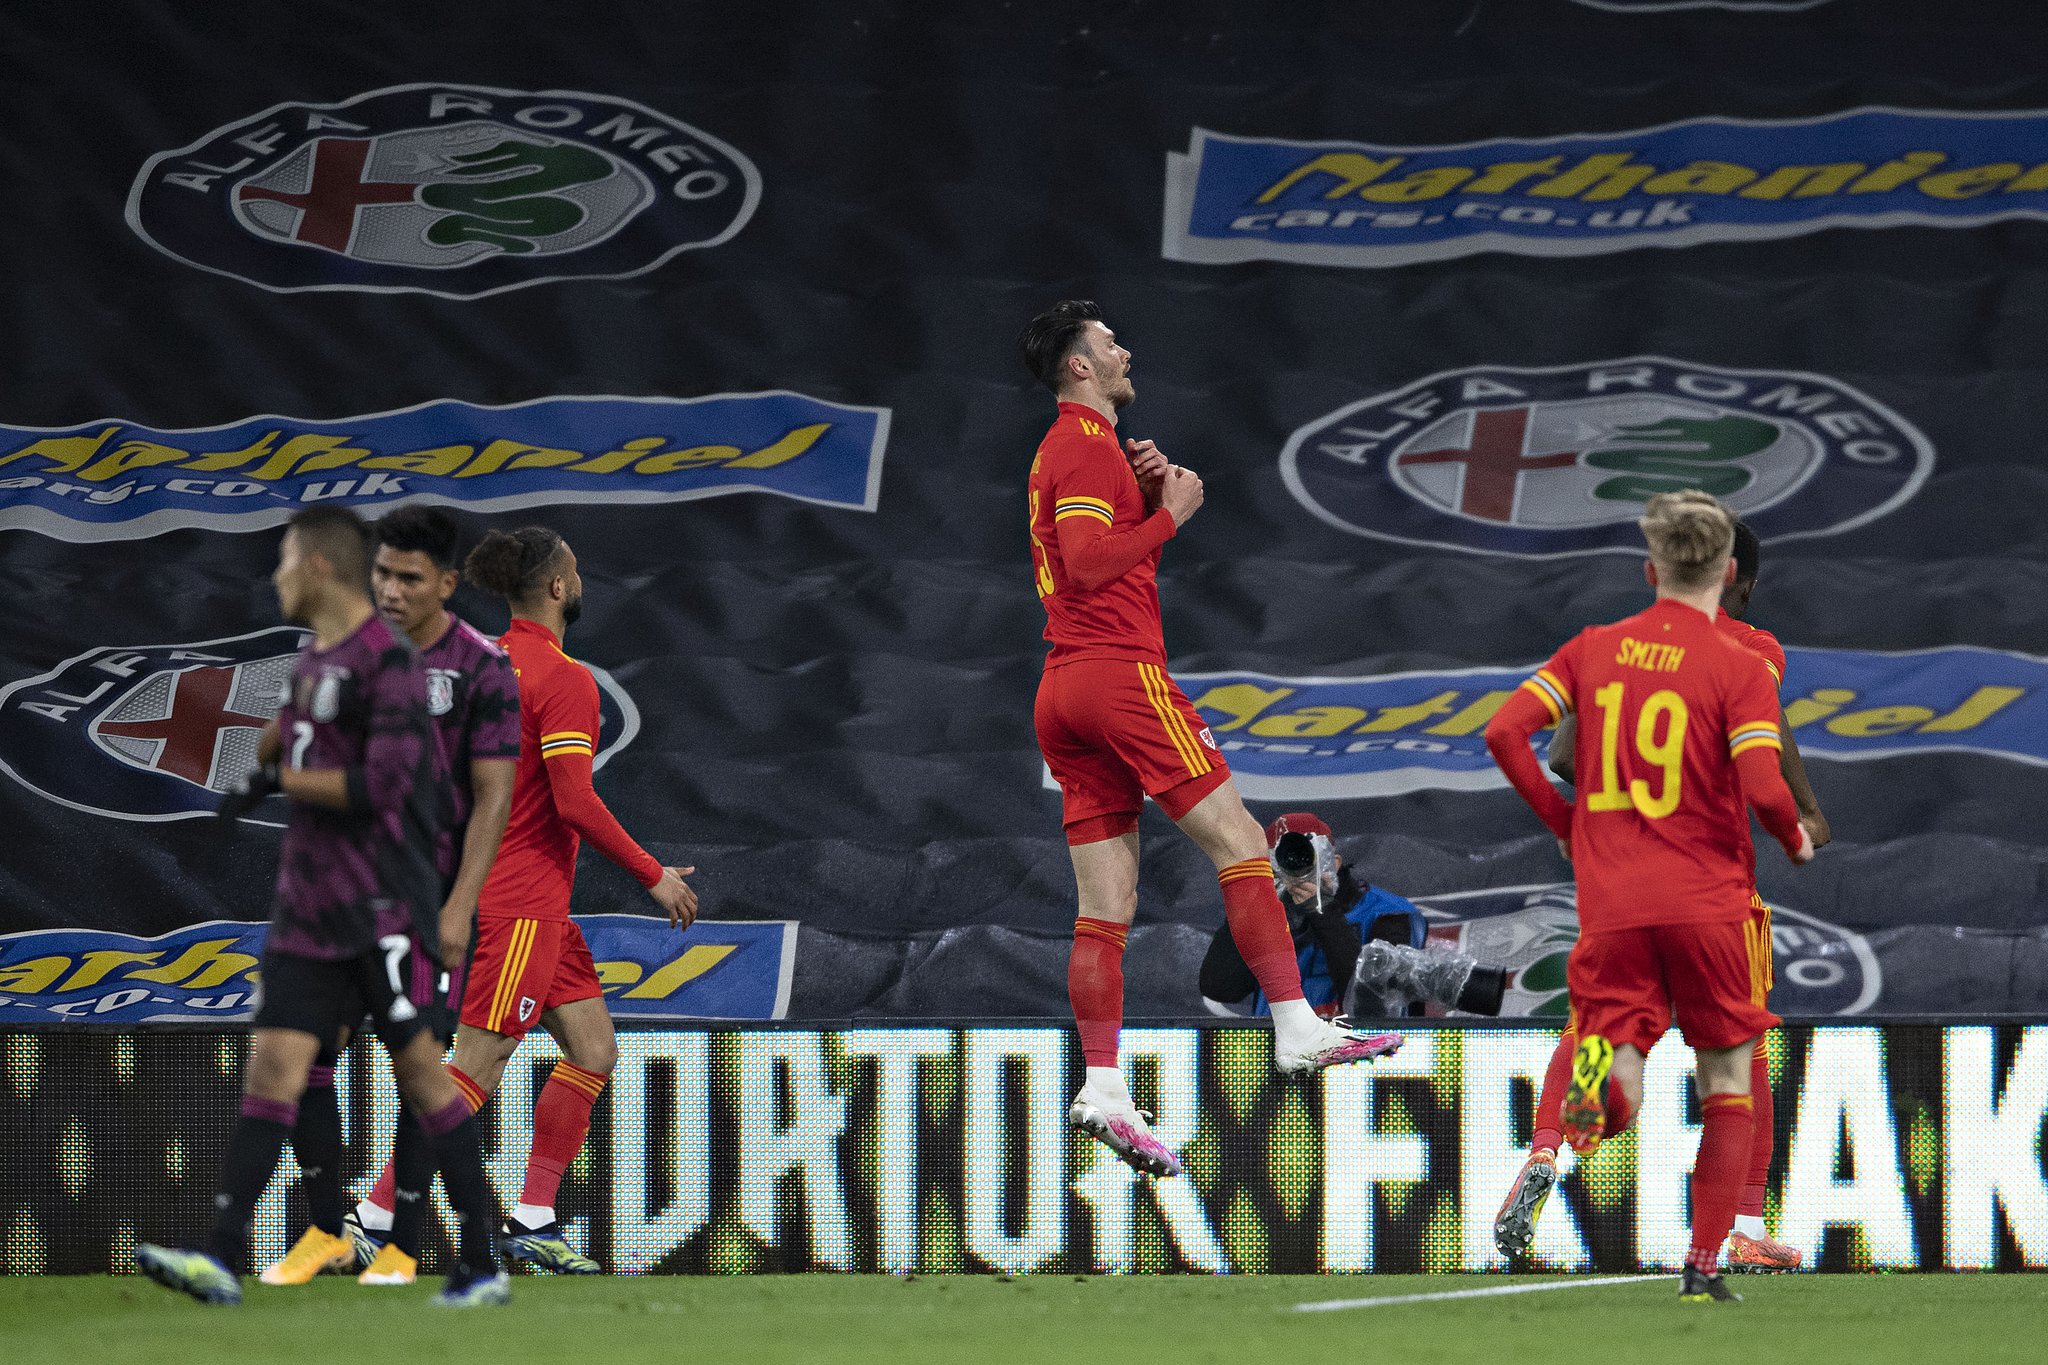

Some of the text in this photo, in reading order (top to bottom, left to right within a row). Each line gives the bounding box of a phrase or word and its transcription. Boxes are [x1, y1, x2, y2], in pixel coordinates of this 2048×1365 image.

[162, 93, 730, 201] ALFA ROMEO
[1230, 200, 1695, 231] cars.co.uk
[1318, 366, 1899, 465] ALFA ROMEO
[18, 650, 236, 723] ALFA
[1616, 636, 1686, 673] SMITH
[1586, 681, 1689, 819] 19
[379, 933, 411, 995] 7
